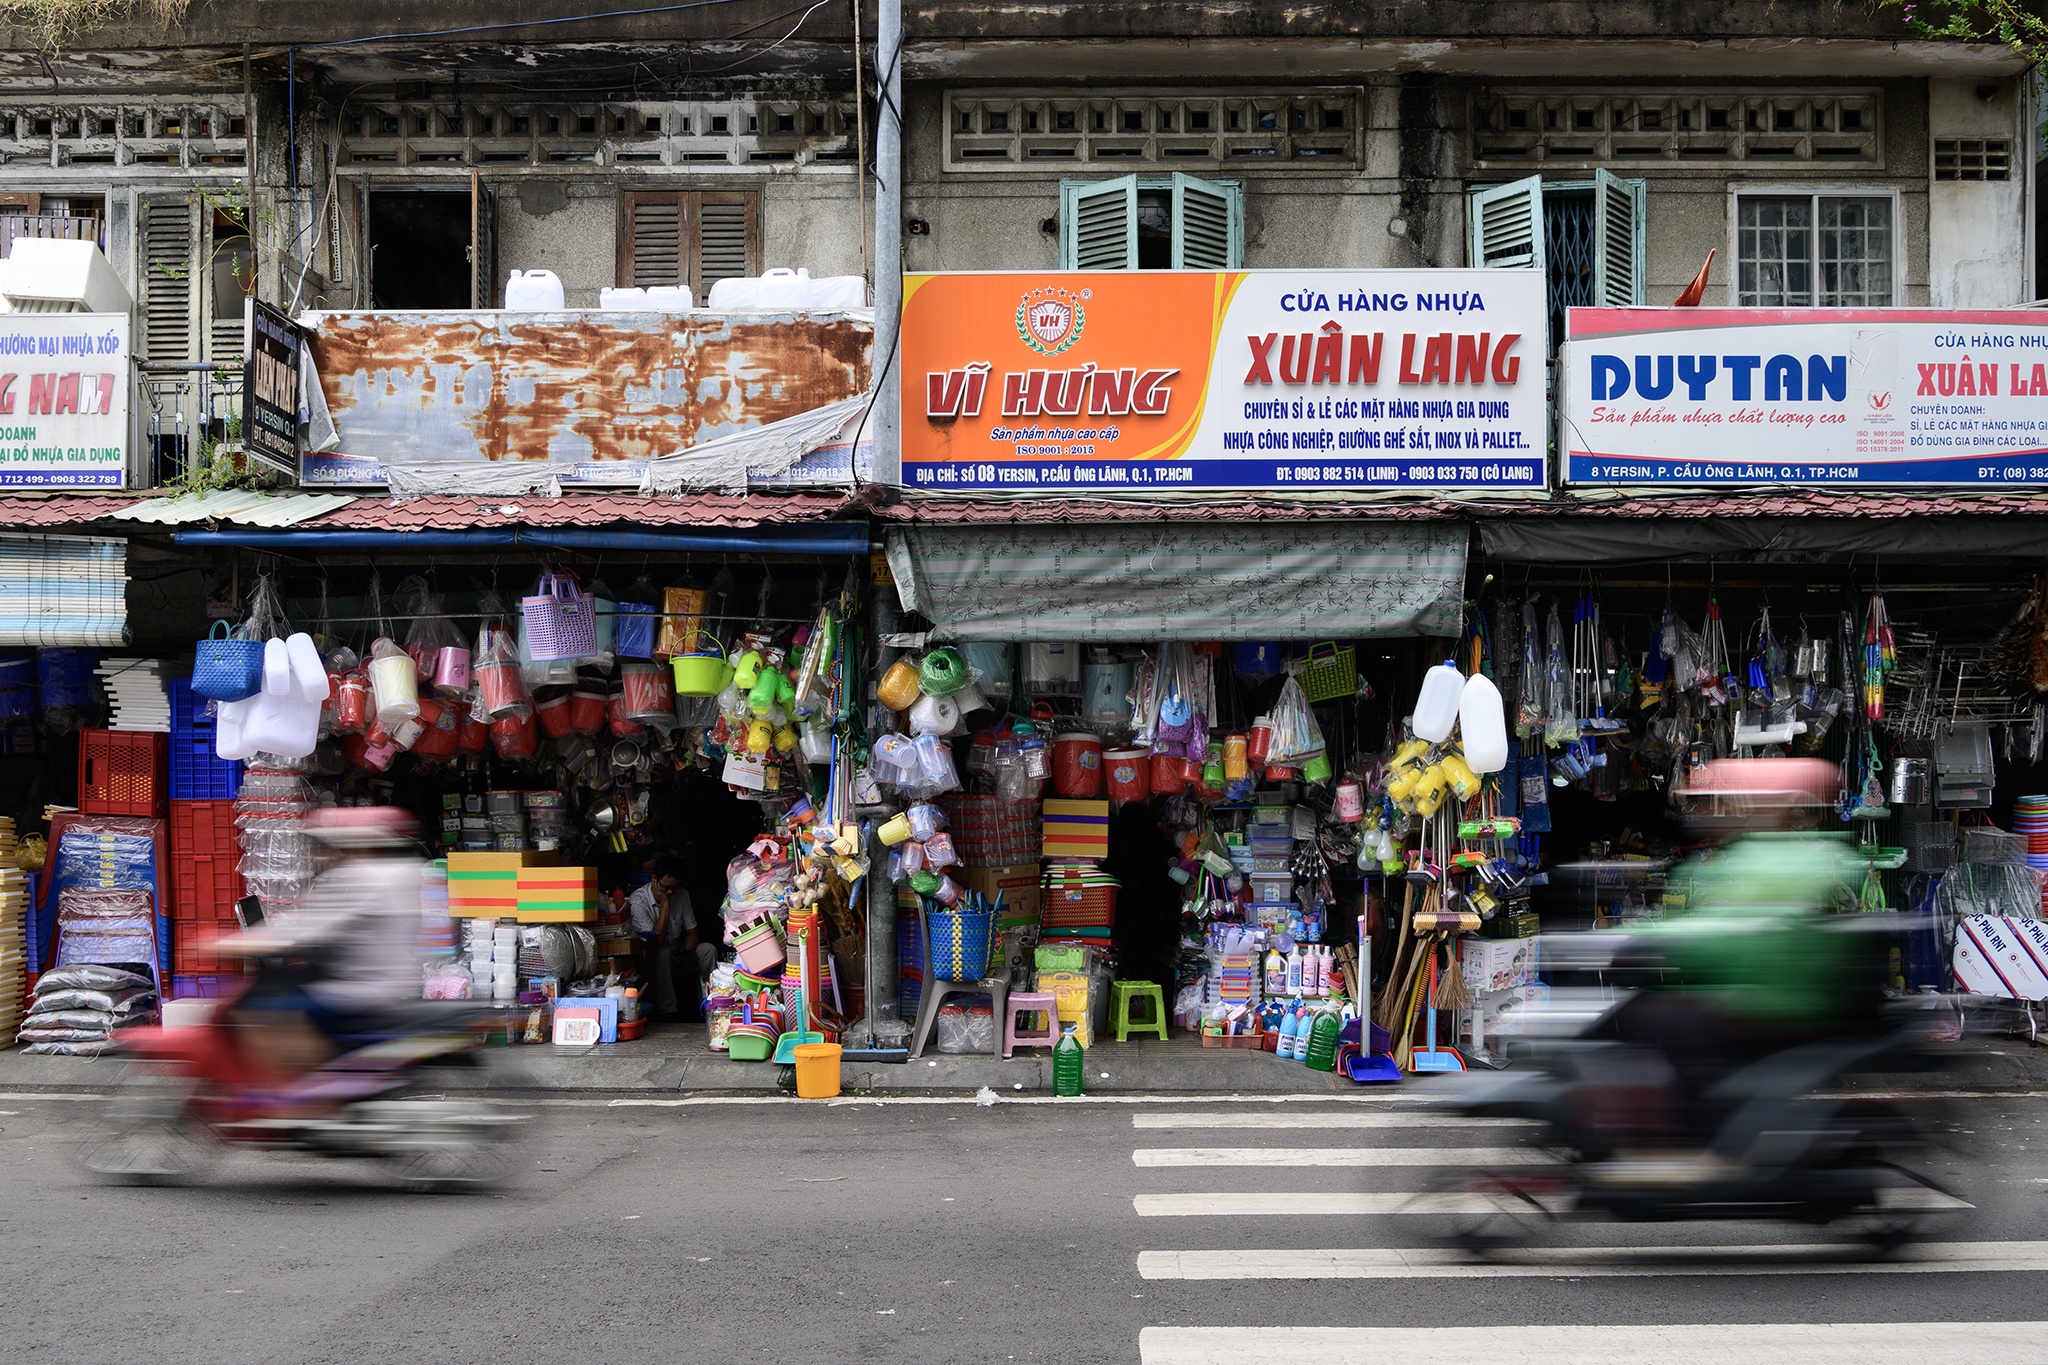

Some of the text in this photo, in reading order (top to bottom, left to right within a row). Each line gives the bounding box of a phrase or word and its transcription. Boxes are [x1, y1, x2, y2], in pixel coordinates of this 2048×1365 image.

[1280, 289, 1485, 315] CỬA HÀNG NHỰA
[1040, 315, 1060, 327] VH
[39, 336, 59, 357] MẠI
[62, 332, 94, 357] NHỰA
[97, 328, 119, 355] XỐP
[1934, 331, 1966, 348] CỬA
[1971, 332, 2015, 348] HÀNG
[1243, 320, 1523, 385] XUÂN LANG
[1591, 354, 1847, 402] DUYTAN
[1916, 354, 1999, 397] XUÂN
[28, 372, 115, 414] NAM
[926, 361, 1181, 417] VĨ HƯNG
[1244, 396, 1509, 422] CHUYÊN SỈ & LẺ CÁC MẶT HÀNG NHỰA GIA DỤNG
[1591, 406, 1847, 428] Sản phẩm nhựa chất lượng cao
[1910, 403, 1985, 415] CHUYÊN DOANH:
[260, 407, 284, 432] YERSIN
[1938, 418, 1957, 430] CÁC
[1960, 419, 1979, 432] MẶT
[1981, 418, 2008, 430] HÀNG
[2010, 420, 2036, 432] NHỰA
[991, 424, 1120, 442] Sản phẩm nhựa cao cấp
[1224, 425, 1530, 453] NHỰA CÔNG NGHIỆP, GIƯỜNG GHẾ SẮT, INOX VÀ PALLET...
[1926, 434, 1953, 446] DÙNG
[1955, 436, 1971, 446] GIA
[1973, 434, 1995, 446] ĐÌNH
[1997, 434, 2017, 446] CÁC
[13, 442, 29, 461] ĐỒ
[32, 446, 64, 464] NHỰA
[67, 447, 86, 461] GIA
[90, 447, 121, 464] DỤNG
[1017, 446, 1036, 455] ISO
[1038, 446, 1062, 455] 9001
[1071, 446, 1094, 455] 2015
[5, 475, 23, 484] 712
[78, 475, 96, 484] 322
[98, 475, 118, 484] 789
[917, 464, 1193, 484] ĐỊA CHỈ: SỐ 08 YERSIN, P.CẦU ÔNG LÃNH, Q.1, TP.HCM
[1276, 467, 1292, 481] ĐT:
[1294, 467, 1320, 481] 0903
[1322, 467, 1342, 481] 882
[1344, 467, 1364, 481] 514
[1367, 466, 1399, 482] (LINH)
[1409, 466, 1435, 480] 0903
[1437, 466, 1457, 480] 033
[1459, 466, 1479, 480] 750
[1481, 464, 1500, 481] (CÔ
[1502, 466, 1533, 481] LANG)
[1591, 462, 1859, 479] 8 YERSIN, P. CẦU ÔNG LÃNH, Q.1, TP.HCM
[1978, 467, 2000, 478] ĐT:
[2003, 467, 2026, 480] (08)
[877, 566, 889, 577] 17
[1990, 935, 2007, 952] RNT
